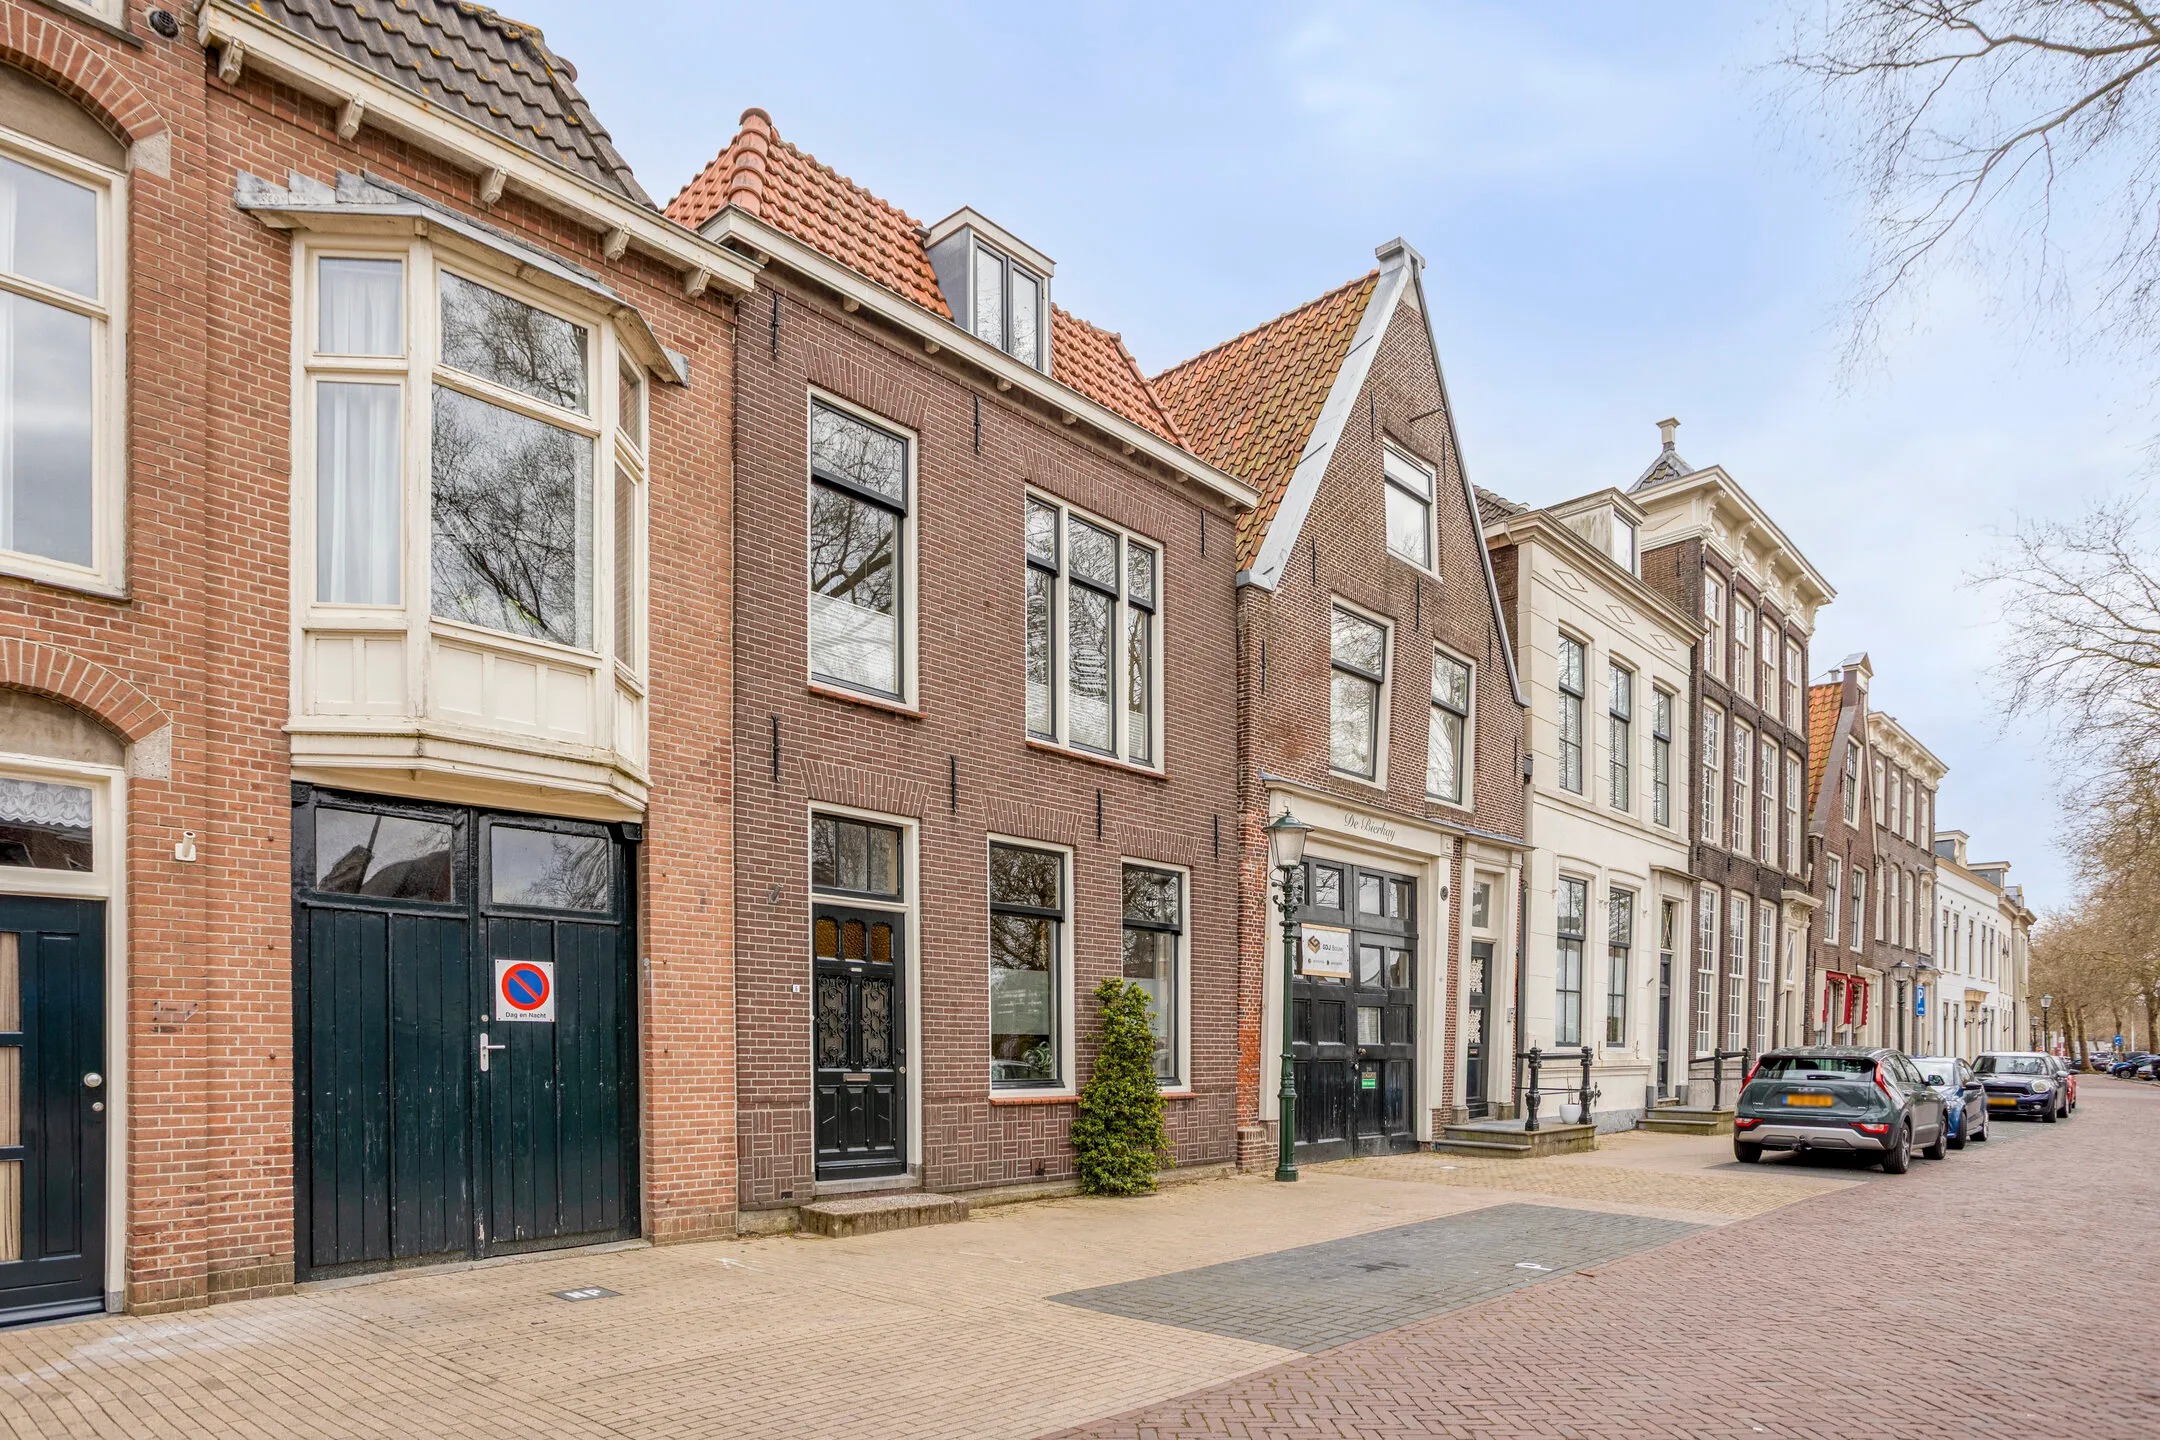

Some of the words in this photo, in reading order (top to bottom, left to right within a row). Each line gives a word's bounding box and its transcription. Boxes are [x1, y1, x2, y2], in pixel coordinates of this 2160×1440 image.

[1344, 812, 1359, 829] De
[1918, 988, 1924, 1004] P
[505, 1011, 518, 1019] Dag
[564, 1289, 602, 1299] NP
